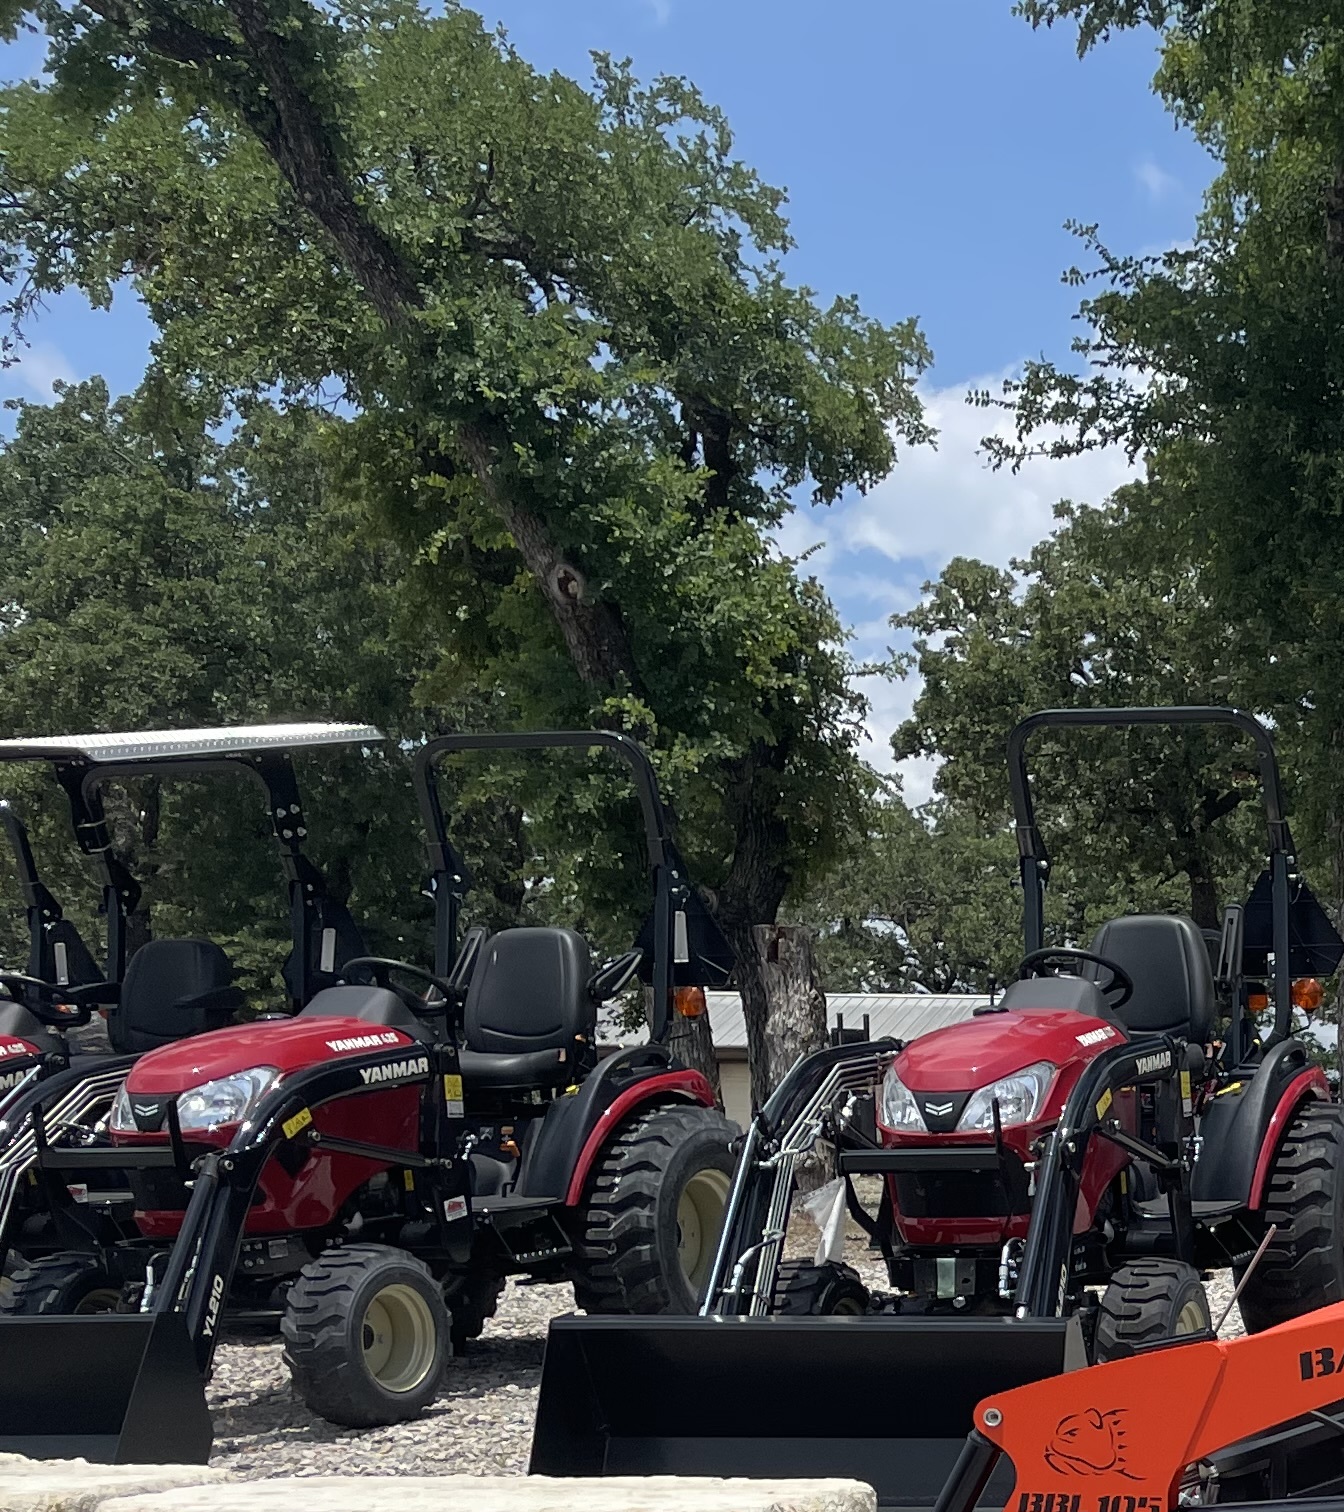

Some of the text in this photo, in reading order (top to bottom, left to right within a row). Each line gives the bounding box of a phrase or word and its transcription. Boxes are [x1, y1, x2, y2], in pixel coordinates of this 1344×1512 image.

[325, 1034, 384, 1052] YANMAR
[359, 1057, 429, 1084] YANMAR
[1135, 1050, 1171, 1075] YANMAR
[202, 1274, 224, 1337] YL210
